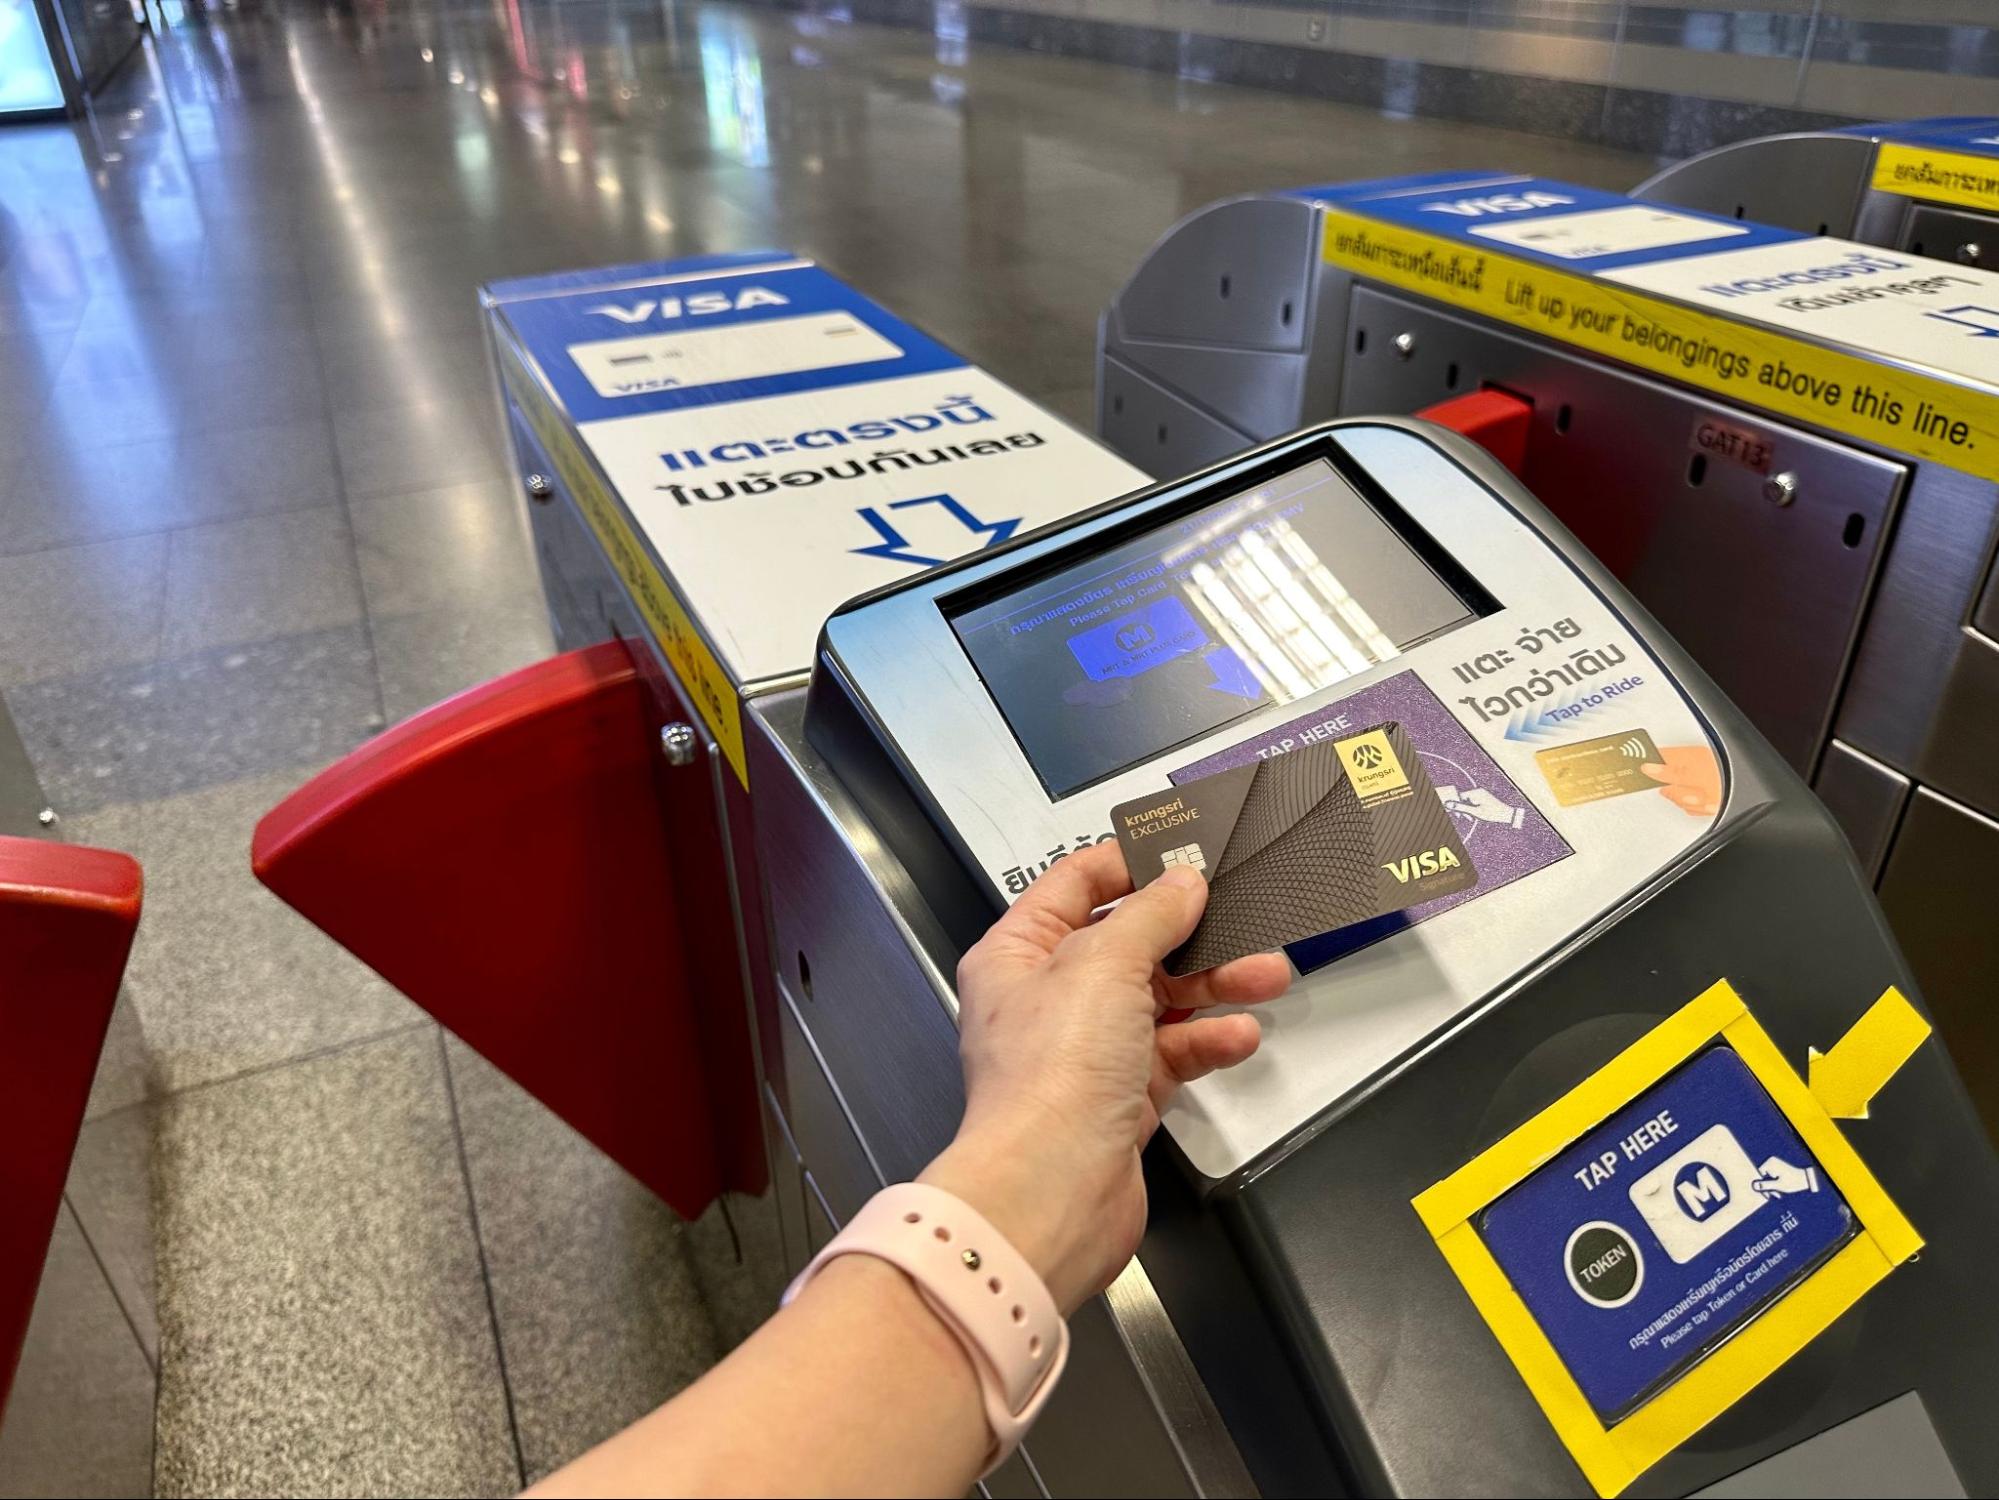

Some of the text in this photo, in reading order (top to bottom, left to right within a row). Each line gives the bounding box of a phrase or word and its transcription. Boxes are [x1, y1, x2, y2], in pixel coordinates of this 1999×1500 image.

[1420, 190, 1576, 217] VISA
[583, 284, 791, 324] VISA
[611, 376, 682, 394] VISA
[1504, 278, 1536, 308] Lift
[1539, 295, 1565, 320] up
[1570, 304, 1619, 333] your
[1622, 313, 1750, 380] belongings
[1758, 358, 1841, 406] above
[1851, 384, 1903, 425] this
[1913, 401, 1975, 450] line.
[657, 394, 998, 473] แตะตรงนี้
[1697, 422, 1765, 466] GAT13
[1069, 580, 1168, 627] Please Tap Card
[1451, 616, 1583, 685] แตะ จ่าย
[1457, 642, 1627, 723] ไวกว่าเดิม
[1546, 673, 1644, 725] Tap to Ride
[1255, 714, 1353, 760] TAP HERE
[1356, 766, 1396, 785] krungsri
[1123, 798, 1184, 828] krungsri
[1129, 808, 1201, 841] EXCLUSIVE
[1381, 846, 1462, 885] VISA
[1573, 1108, 1680, 1193] TAP HERE
[1579, 1243, 1628, 1285] TOKEN
[1659, 1248, 1789, 1349] Please tap Token or Card here
